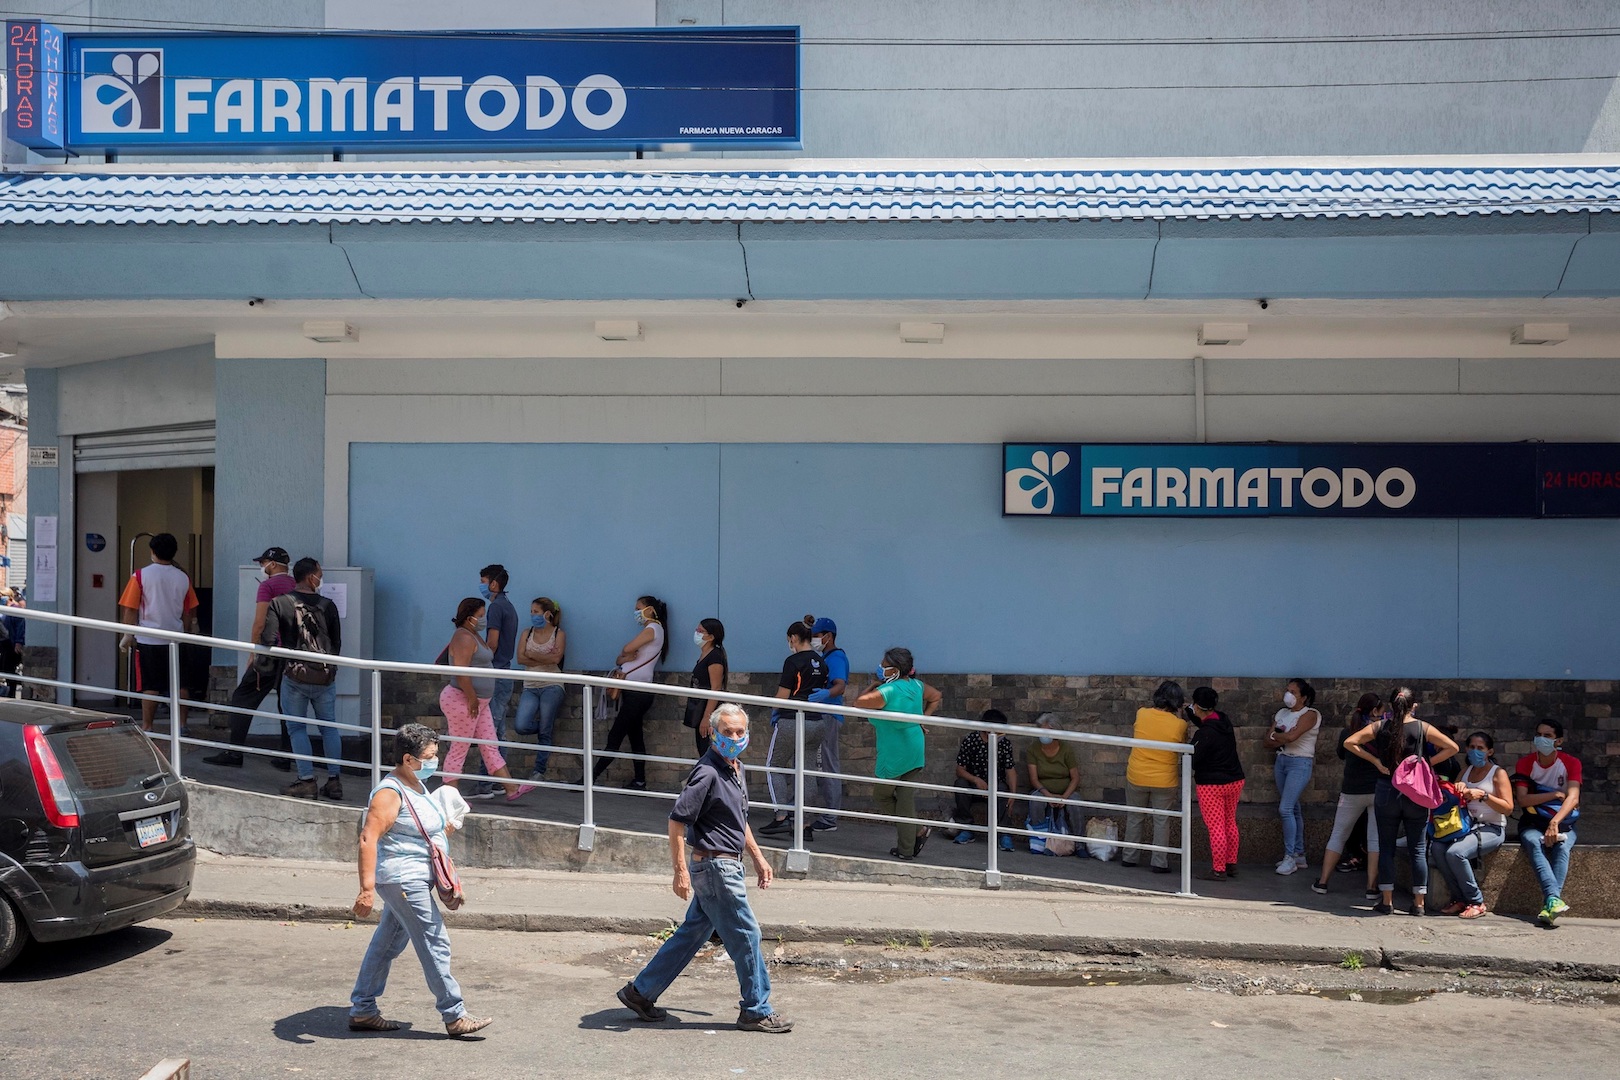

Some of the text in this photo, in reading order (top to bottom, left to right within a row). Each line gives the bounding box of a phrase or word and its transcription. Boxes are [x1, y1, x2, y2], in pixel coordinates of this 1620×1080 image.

[11, 26, 38, 128] 24 HORAS
[44, 29, 60, 135] 24 HORAS
[175, 74, 627, 132] FARMATODO
[1092, 467, 1416, 508] FARMATODO
[1545, 471, 1620, 489] 24 HORAS
